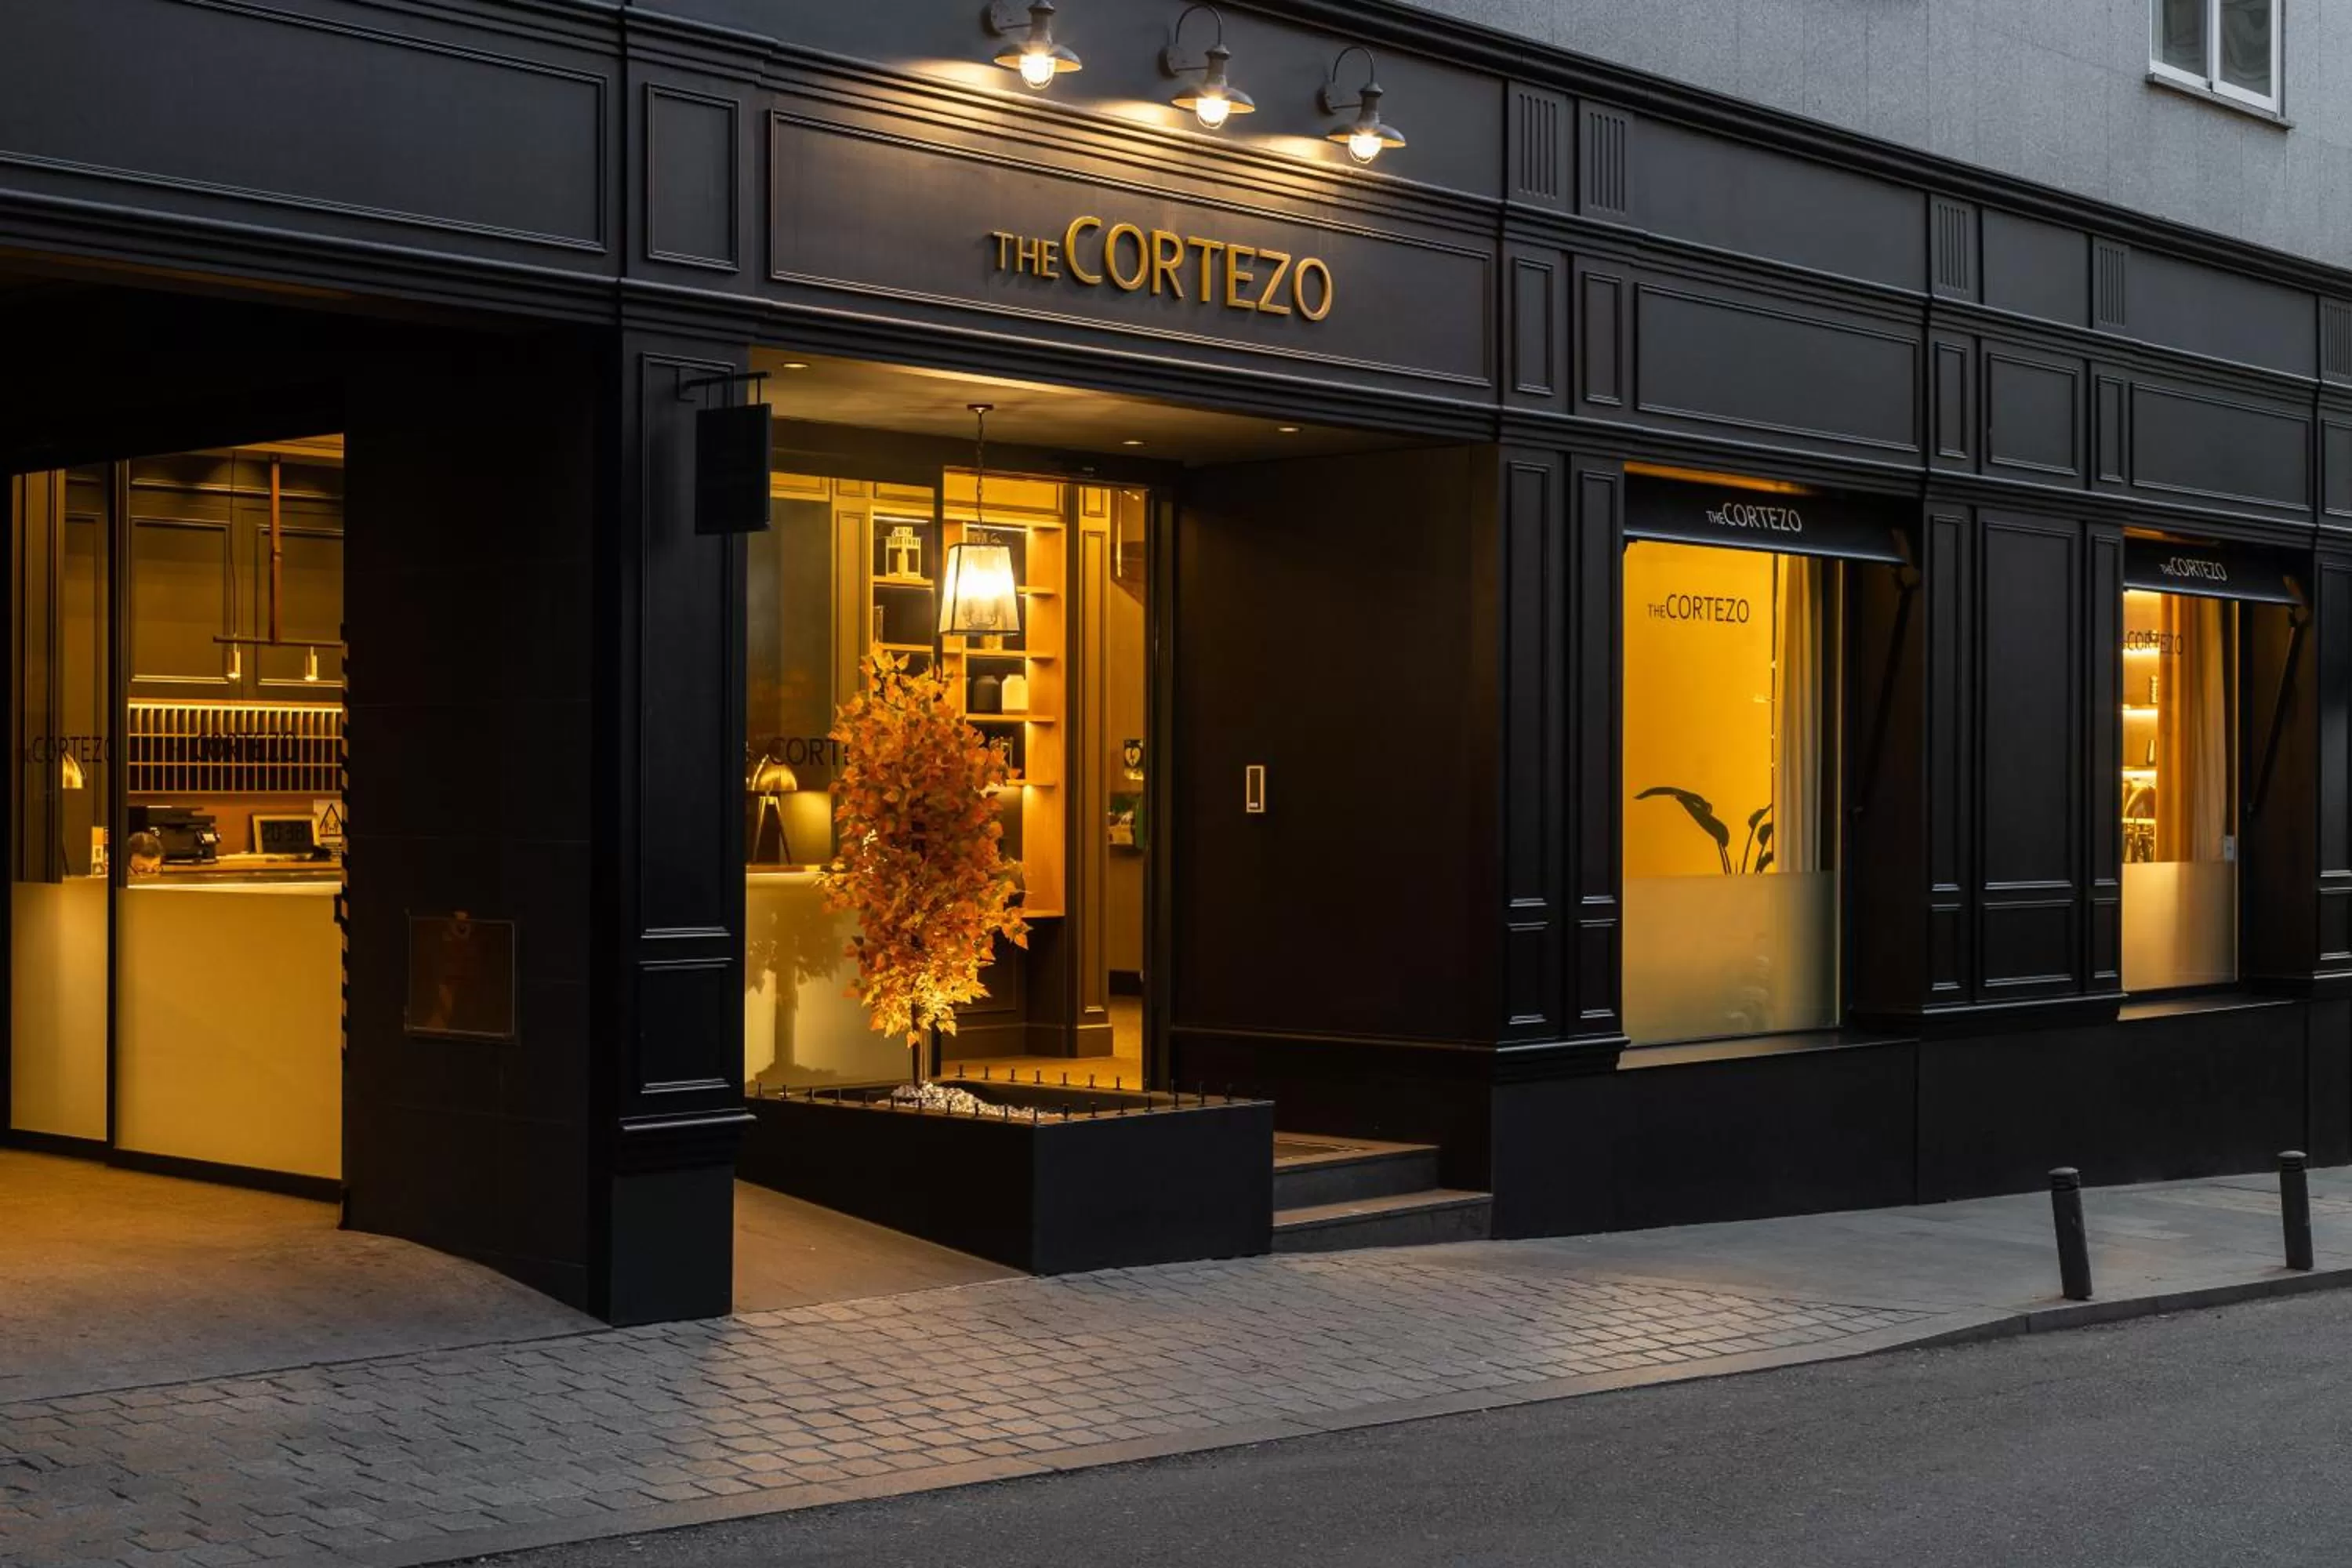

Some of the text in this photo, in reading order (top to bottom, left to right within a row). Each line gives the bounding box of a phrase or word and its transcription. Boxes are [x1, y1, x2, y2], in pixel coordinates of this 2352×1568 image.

[992, 215, 1333, 321] THE CORTEZO
[1706, 503, 1803, 532] THE CORTEZO
[2169, 557, 2228, 581] CORTEZO
[1647, 593, 1750, 624] THE CORTEZO
